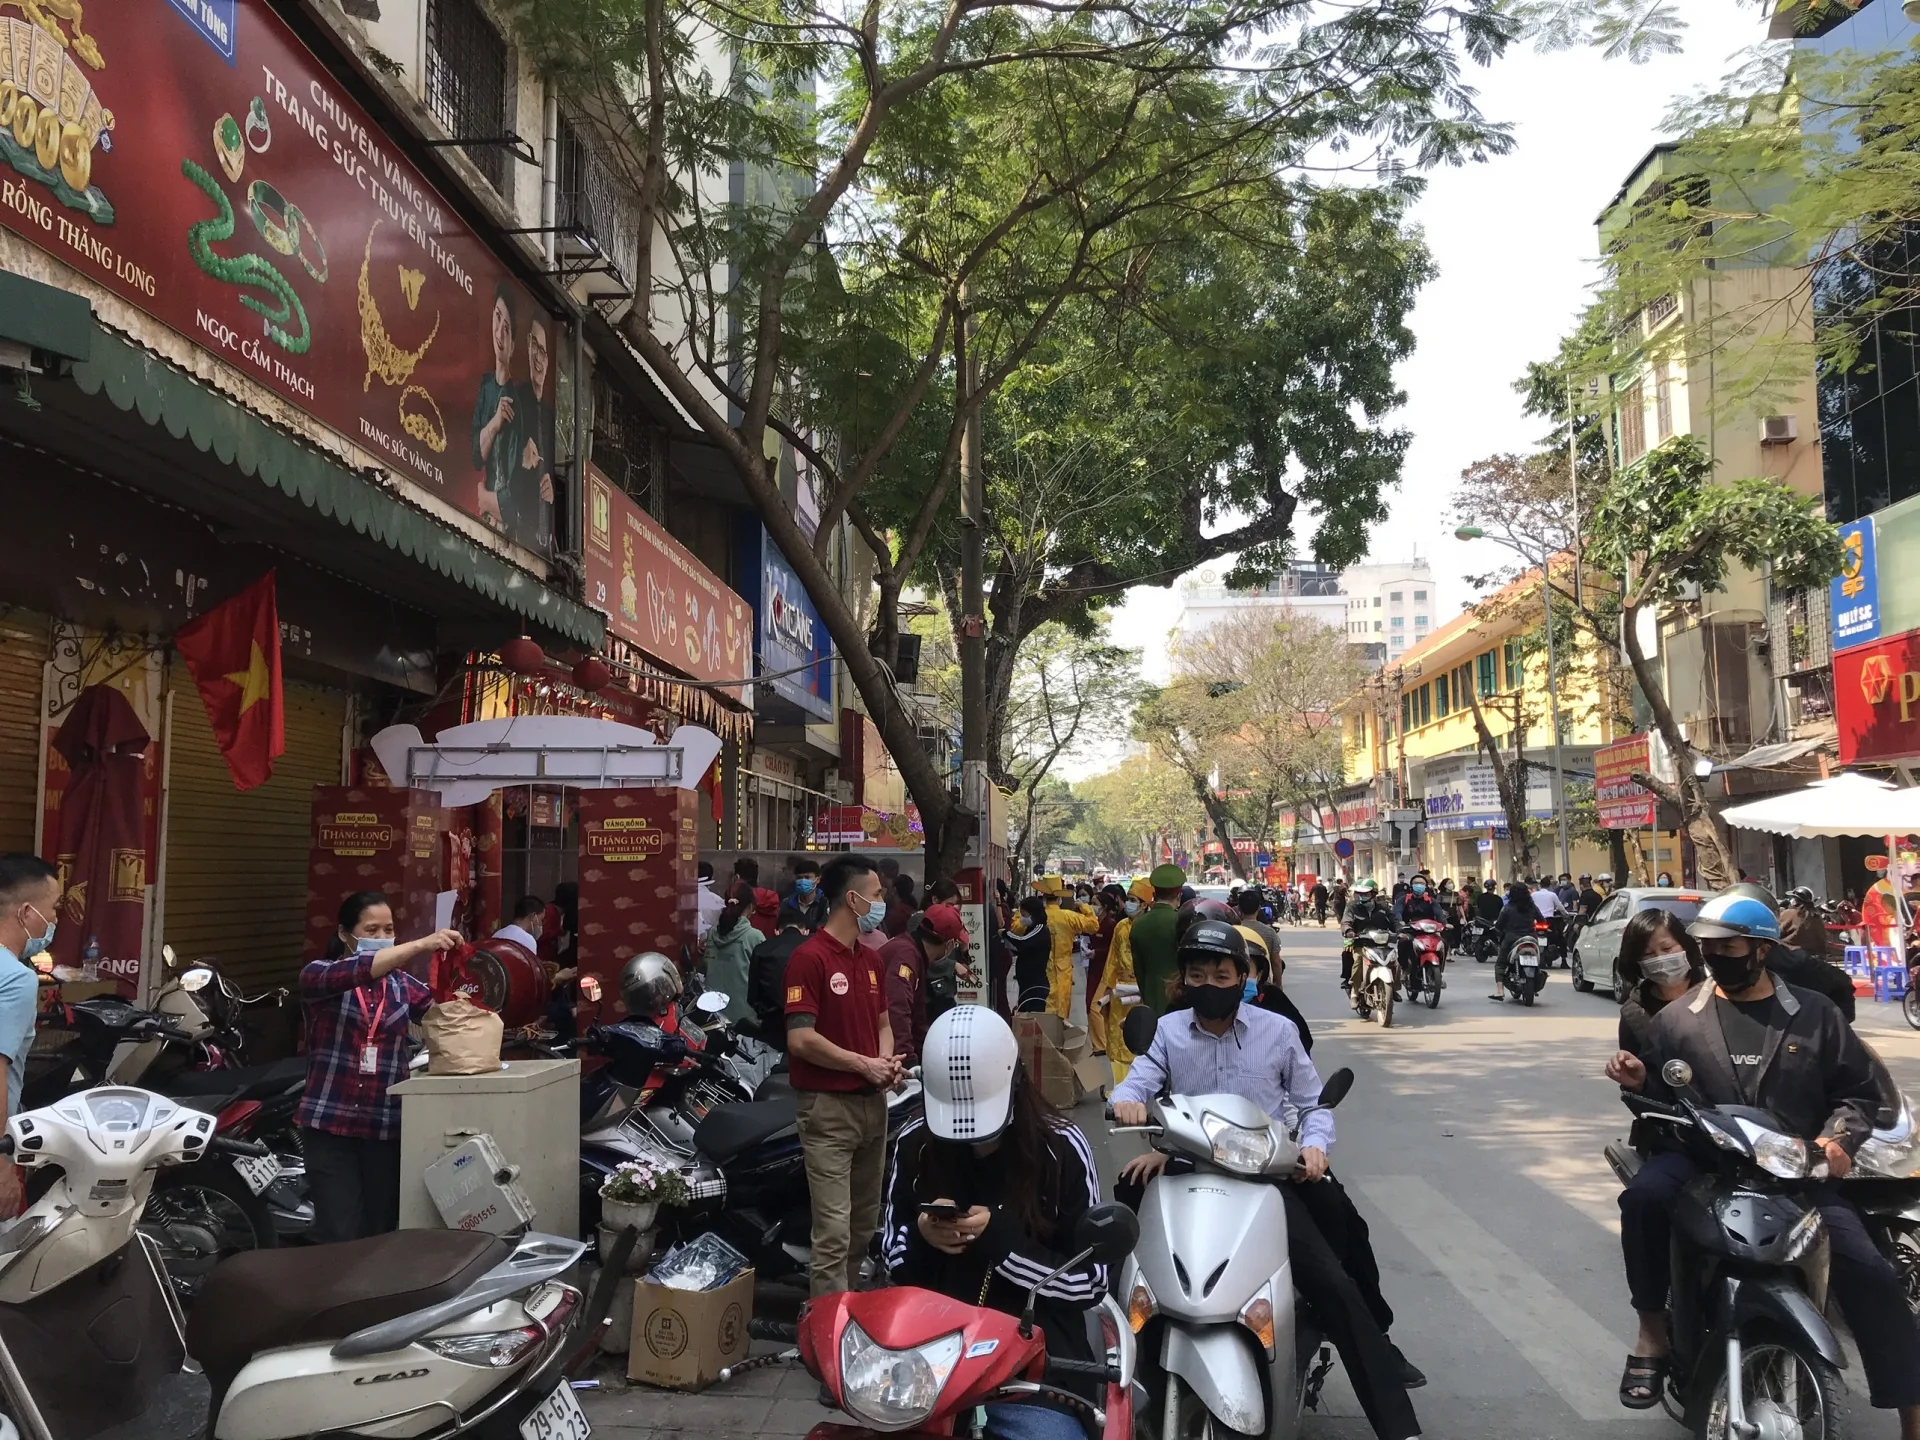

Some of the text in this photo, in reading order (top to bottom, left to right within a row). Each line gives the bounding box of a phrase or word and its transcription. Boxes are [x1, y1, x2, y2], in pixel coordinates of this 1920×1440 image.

[310, 80, 443, 235] CHUYÊN VÀNG VÀ
[262, 64, 474, 296] TRANG SỨC TRUYỀN THỐNG
[1, 178, 156, 297] RỒNG THĂNG LONG
[196, 308, 314, 401] NGỌC CẨM THẠCH
[359, 416, 444, 485] TRANG SỨC VÀNG TA
[596, 580, 606, 602] 29
[764, 755, 782, 773] CHÁO
[606, 820, 624, 828] VÀNG
[321, 829, 390, 842] THĂNG LONG
[589, 834, 660, 847] THĂNG LONG
[1730, 1054, 1763, 1065] NASA
[251, 1158, 278, 1189] 9119
[1732, 1191, 1769, 1200] HONDA
[460, 1203, 498, 1232] 19001515
[529, 1290, 553, 1313] HONDA
[971, 1342, 995, 1353] FI
[353, 1367, 431, 1386] LEAD
[530, 1388, 571, 1440] 29-G1
